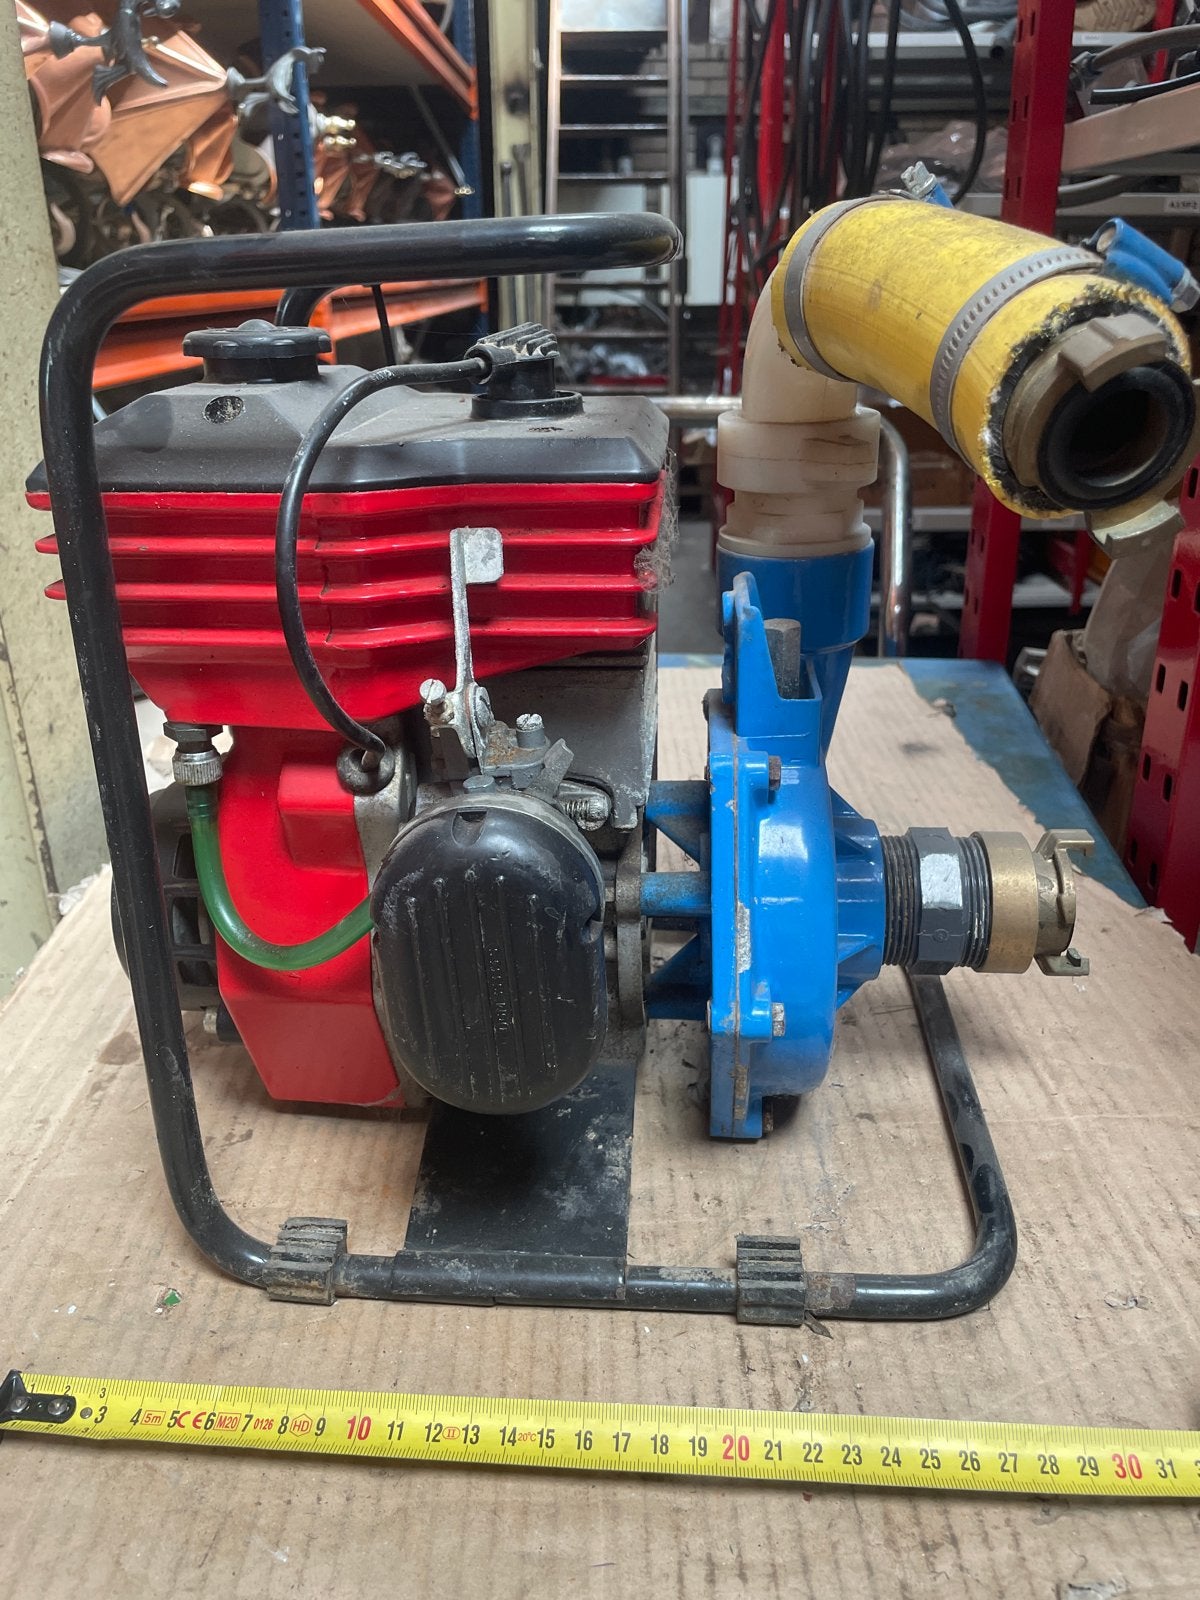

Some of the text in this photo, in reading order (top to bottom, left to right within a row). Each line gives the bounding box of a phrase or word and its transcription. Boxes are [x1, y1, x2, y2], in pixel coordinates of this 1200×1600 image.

[64, 1385, 71, 1395] 2
[99, 1387, 107, 1399] 3
[94, 1405, 108, 1424] 3
[129, 1408, 143, 1426] 4
[144, 1413, 162, 1424] 5m
[167, 1410, 180, 1428] 5
[176, 1410, 207, 1430] CE
[203, 1411, 217, 1431] 6
[216, 1414, 238, 1429] M20
[241, 1414, 254, 1432] 7
[253, 1417, 274, 1431] 0126
[277, 1415, 290, 1435] 8
[292, 1420, 310, 1432] HD
[314, 1417, 327, 1437] 9
[347, 1416, 372, 1441] 10
[387, 1420, 404, 1441] 11
[424, 1422, 443, 1443] 12
[461, 1424, 480, 1445] 13
[499, 1426, 517, 1447] 14
[536, 1427, 555, 1449] 15
[574, 1430, 593, 1451] 16
[612, 1432, 631, 1453] 17
[650, 1433, 669, 1455] 18
[688, 1436, 708, 1457] 19
[722, 1434, 750, 1462] 20
[763, 1440, 783, 1461] 21
[802, 1442, 823, 1464] 22
[841, 1444, 863, 1466] 23
[880, 1446, 902, 1468] 24
[919, 1448, 941, 1470] 25
[958, 1450, 981, 1472] 26
[998, 1452, 1018, 1473] 27
[1037, 1454, 1060, 1476] 28
[1076, 1456, 1100, 1477] 29
[1111, 1453, 1143, 1480] 30
[1155, 1458, 1177, 1479] 31
